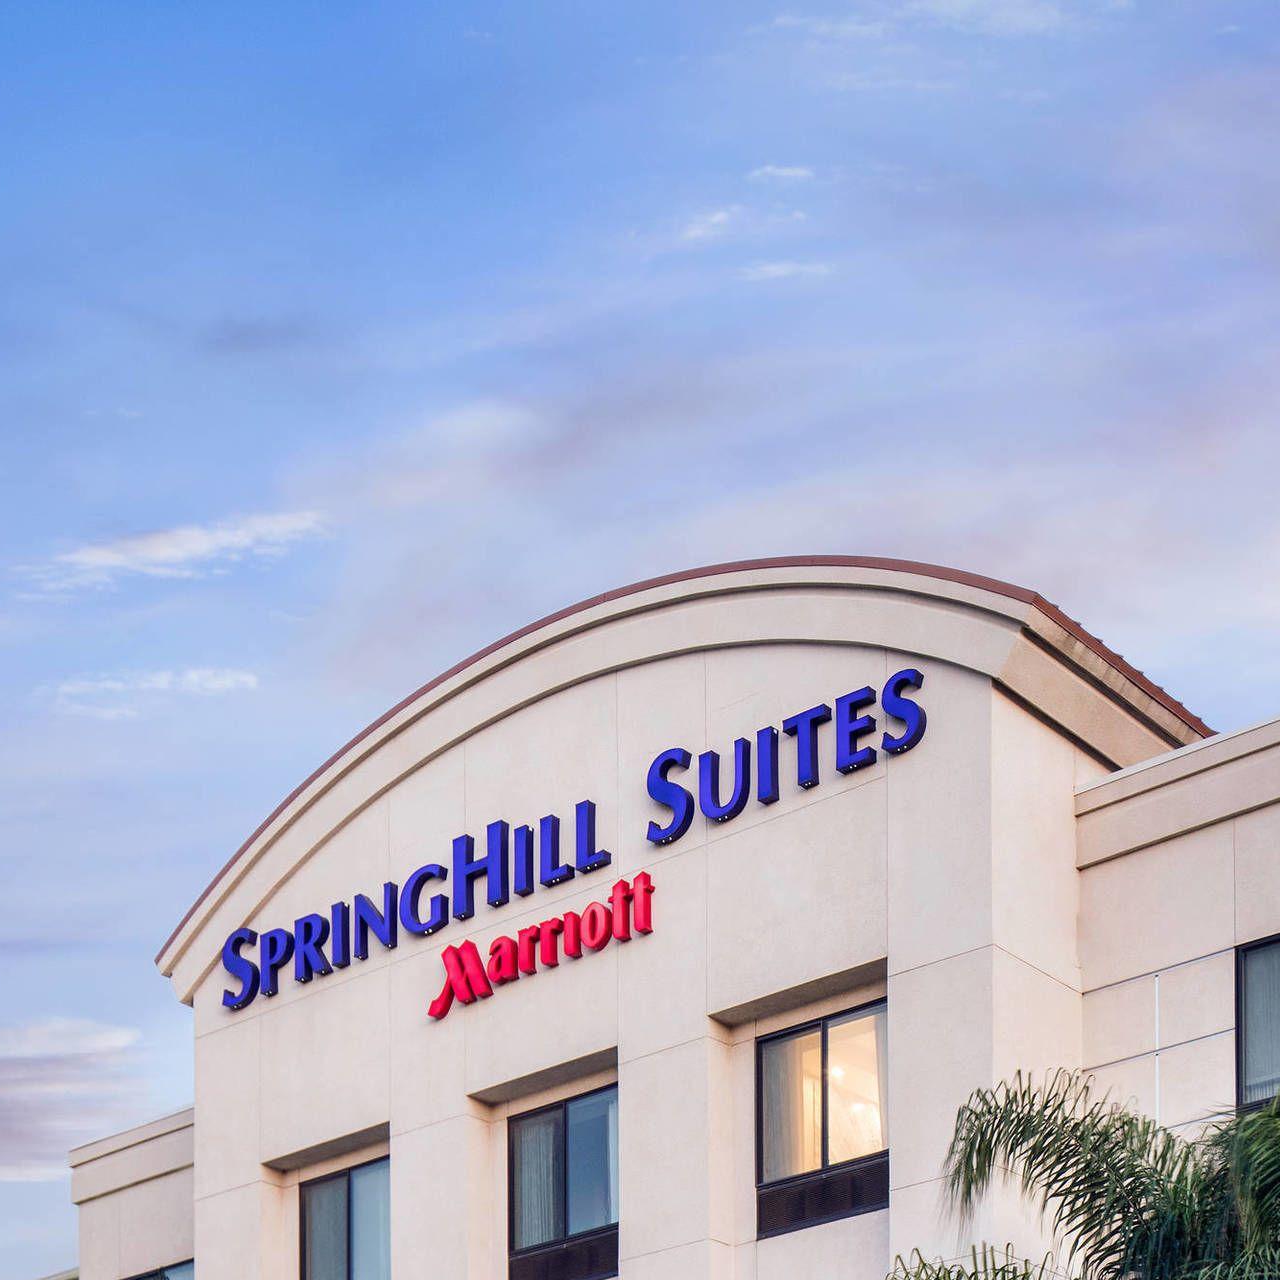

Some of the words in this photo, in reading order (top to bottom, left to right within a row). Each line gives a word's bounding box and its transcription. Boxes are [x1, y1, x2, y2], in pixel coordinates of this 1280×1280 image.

[222, 800, 612, 1011] SPRINGHILL
[647, 668, 927, 845] SUITES
[428, 871, 656, 1020] Marriott
